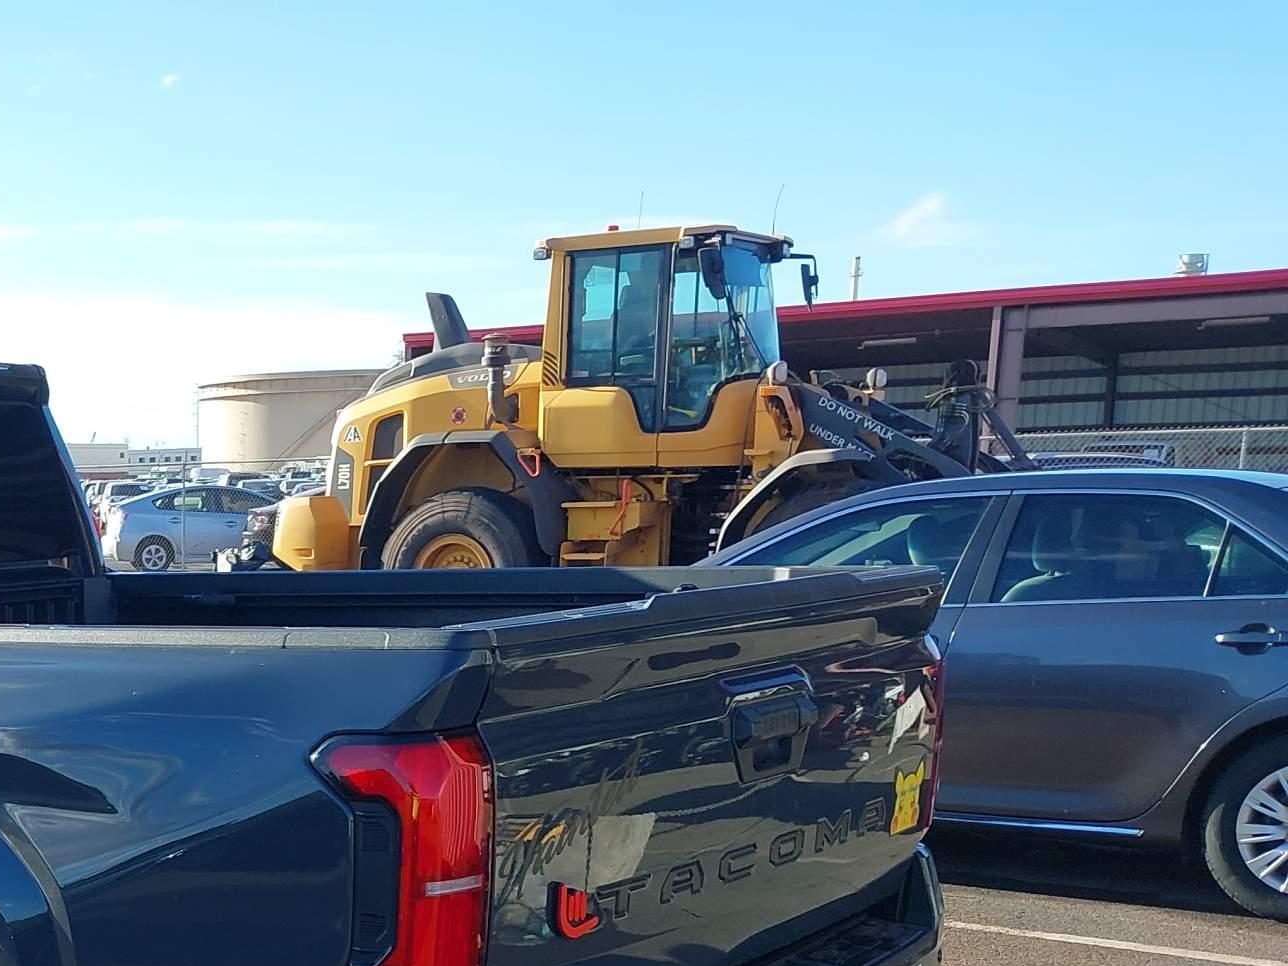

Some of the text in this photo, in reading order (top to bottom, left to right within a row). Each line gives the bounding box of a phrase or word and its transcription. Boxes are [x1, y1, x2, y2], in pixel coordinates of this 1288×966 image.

[457, 370, 512, 384] VOLO
[818, 396, 895, 441] DO NOT WALK
[809, 423, 845, 448] UNDER
[337, 463, 351, 490] L70H
[595, 796, 888, 921] TACOMA
